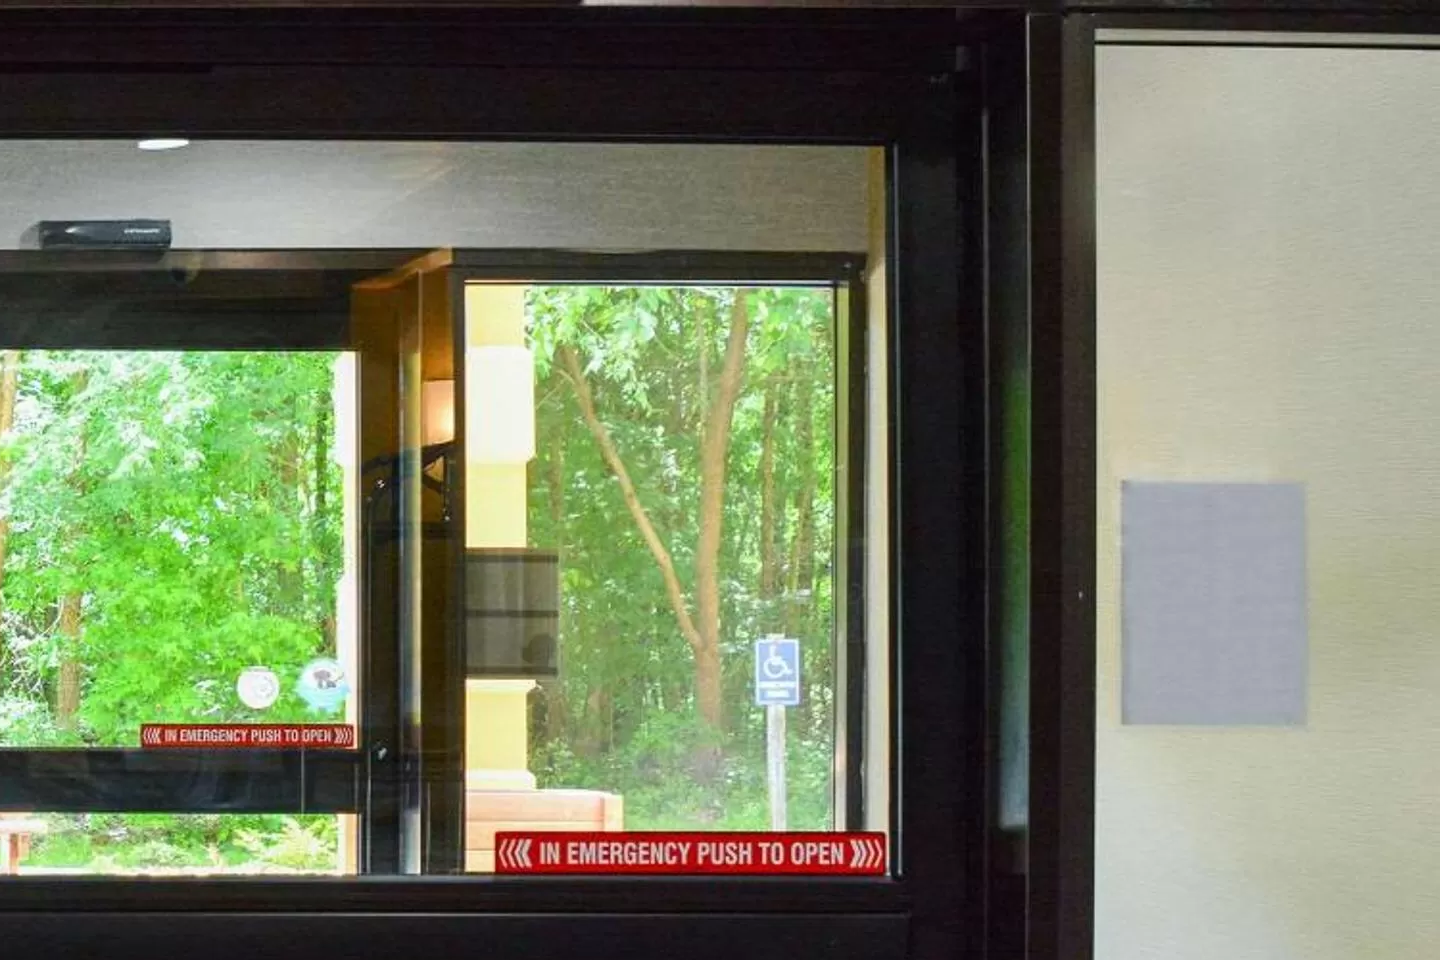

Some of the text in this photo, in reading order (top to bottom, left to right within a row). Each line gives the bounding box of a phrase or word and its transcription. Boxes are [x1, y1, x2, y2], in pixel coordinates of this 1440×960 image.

[164, 729, 333, 743] IN EMERGENCY PUSH TO OPEN
[539, 841, 845, 866] IN EMERGENCY PUSH TO OPEN
